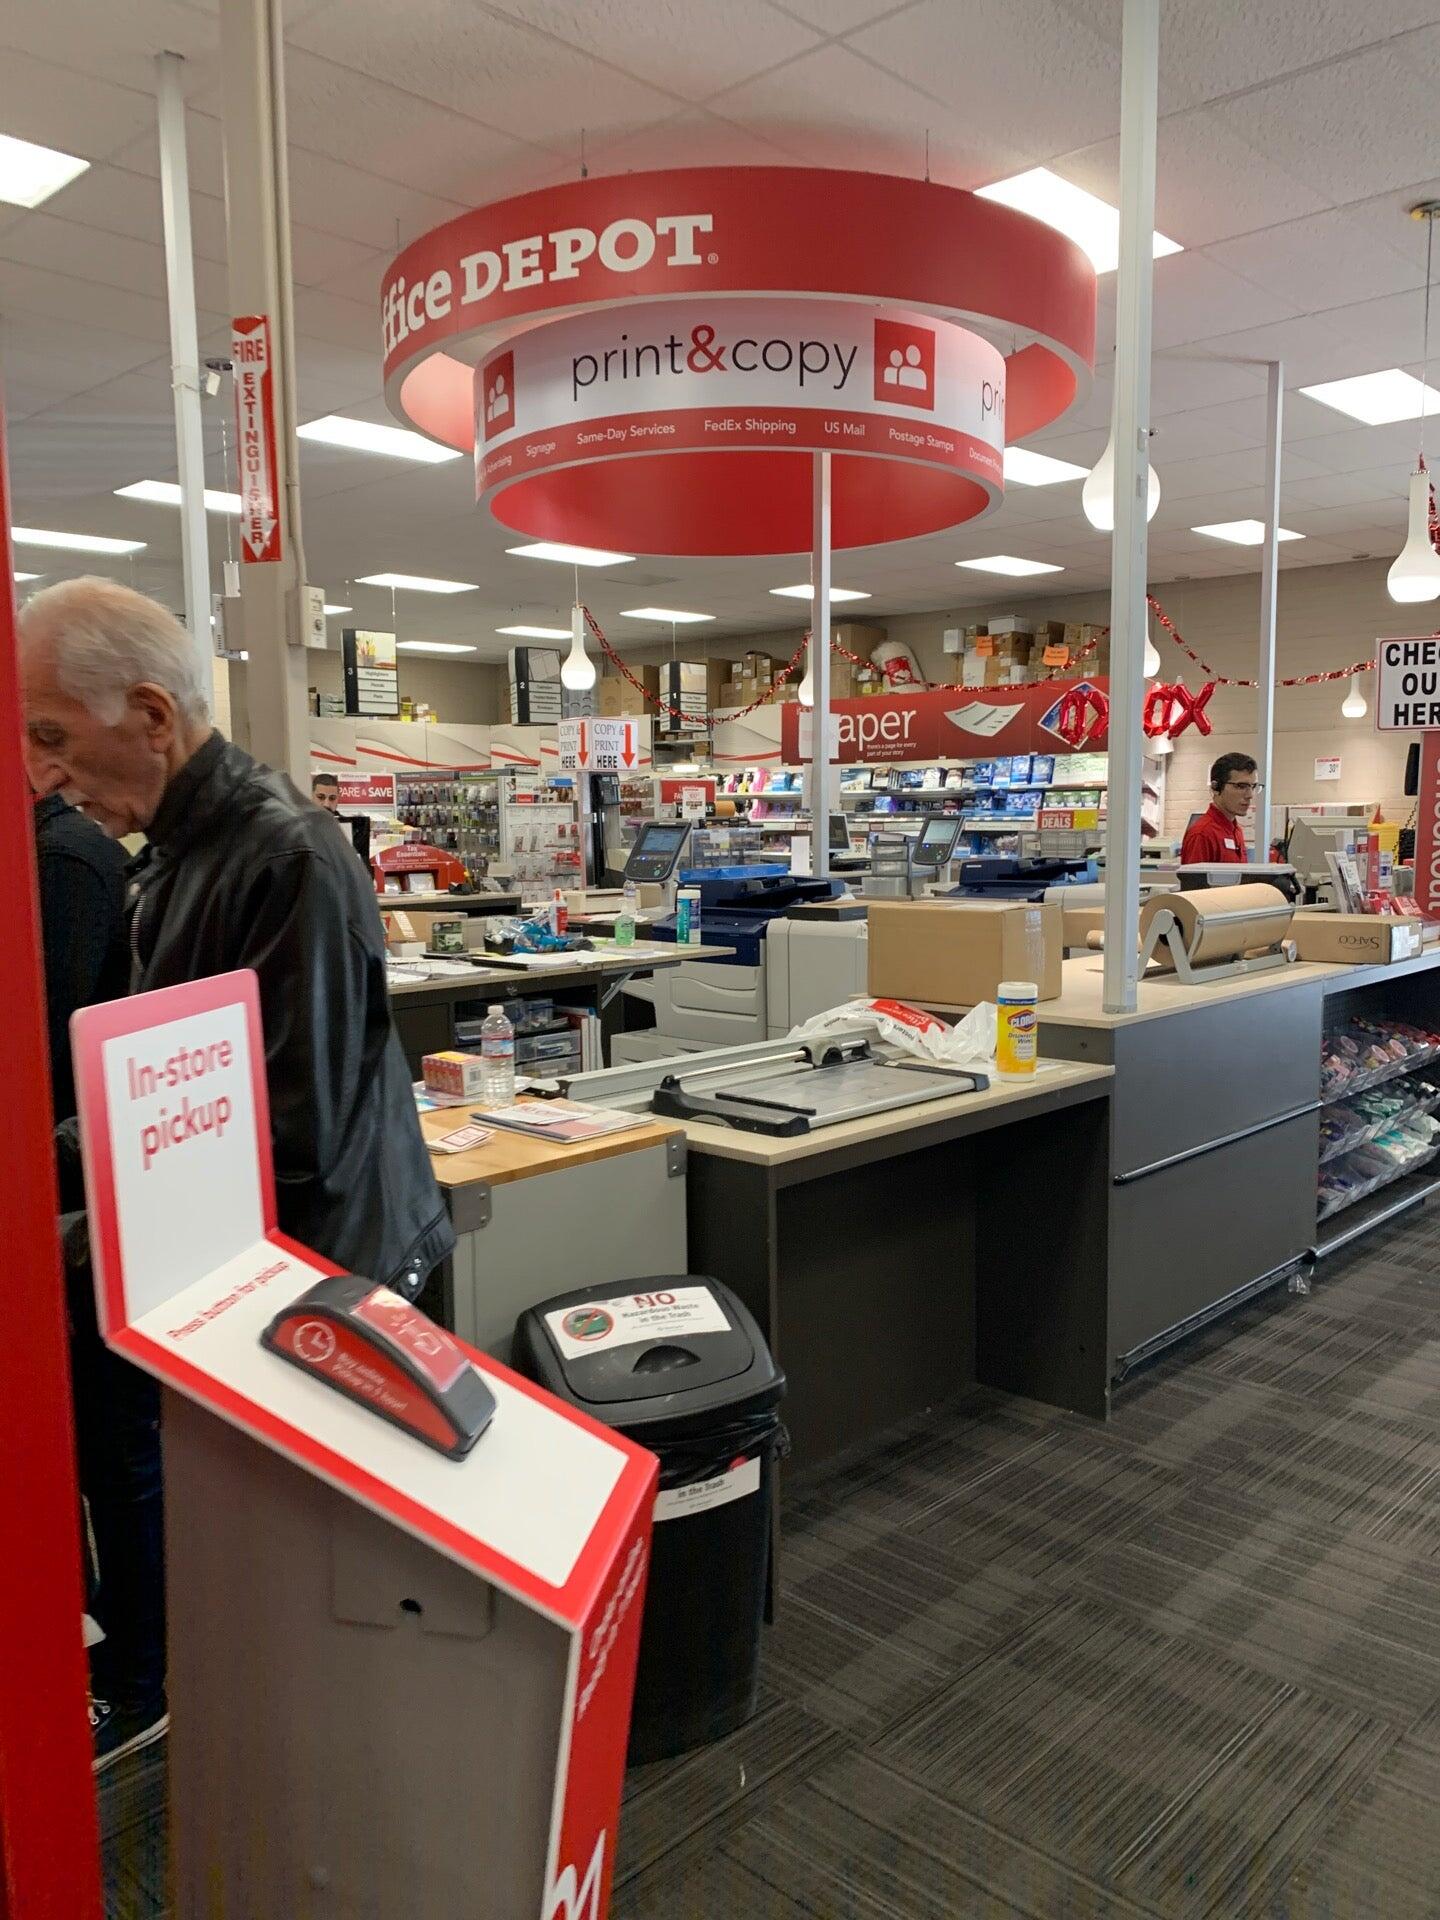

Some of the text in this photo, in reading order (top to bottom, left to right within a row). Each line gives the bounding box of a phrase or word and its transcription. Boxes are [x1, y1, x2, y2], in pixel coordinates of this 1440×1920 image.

[382, 213, 714, 362] ffice DEPOT
[233, 339, 263, 362] FIRE
[704, 418, 797, 434] FedEx Shipping
[824, 421, 866, 436] US Mail
[576, 423, 676, 446] Same-Day Services
[889, 427, 955, 452] Postage Stamps
[526, 441, 556, 458] Signage
[1386, 642, 1440, 667] CHE
[519, 681, 526, 689] 2
[560, 725, 575, 737] COPY
[594, 723, 617, 735] COPY
[838, 710, 917, 752] aper
[560, 741, 577, 752] PRINT
[594, 740, 619, 752] PRINT
[562, 755, 576, 768] HERE
[596, 755, 618, 769] HERE
[368, 787, 393, 798] SAVE
[1041, 817, 1072, 829] DEALS
[1010, 1013, 1039, 1027] CLORO
[127, 1039, 233, 1101] In-store
[140, 1096, 232, 1171] pickup
[633, 1292, 676, 1308] NO
